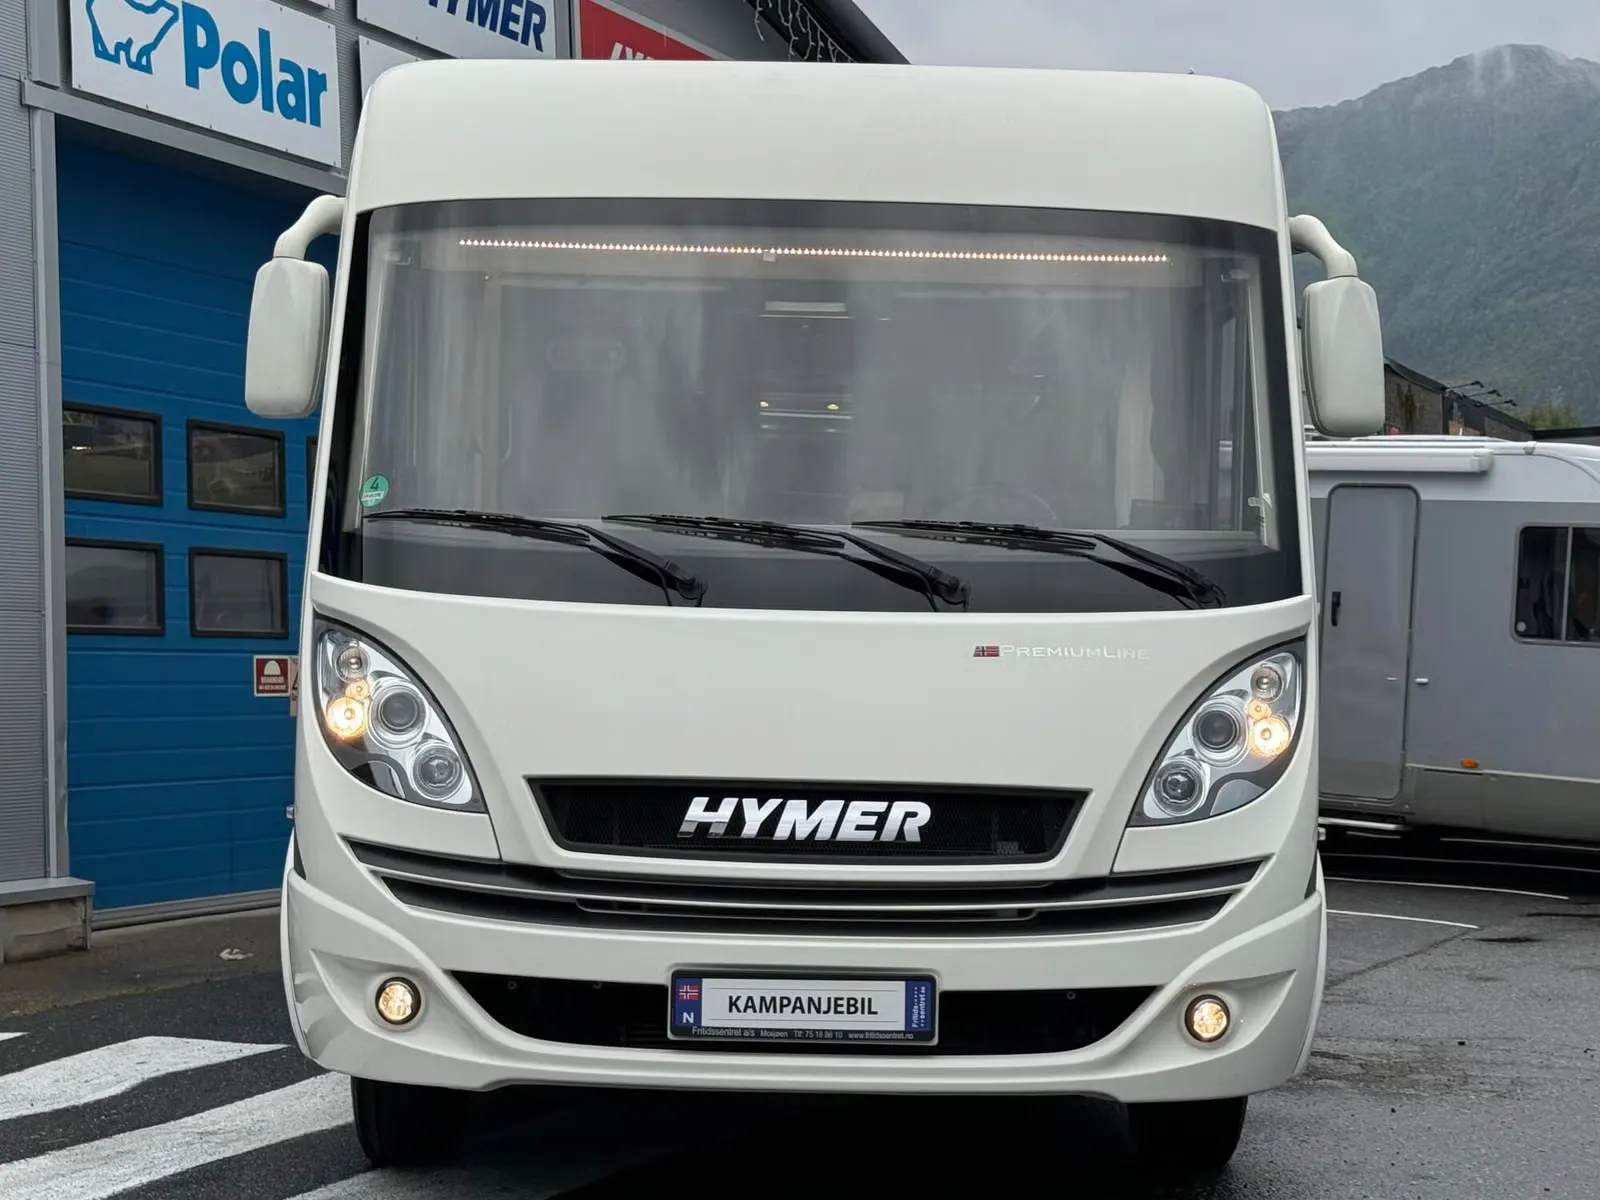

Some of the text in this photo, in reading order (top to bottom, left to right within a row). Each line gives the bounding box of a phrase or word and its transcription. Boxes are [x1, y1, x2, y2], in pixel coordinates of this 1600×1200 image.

[428, 0, 547, 52] MER
[181, 1, 328, 128] Polar
[676, 796, 932, 842] HYMER
[682, 1012, 694, 1024] N
[728, 995, 879, 1015] KAMPANJEBIL
